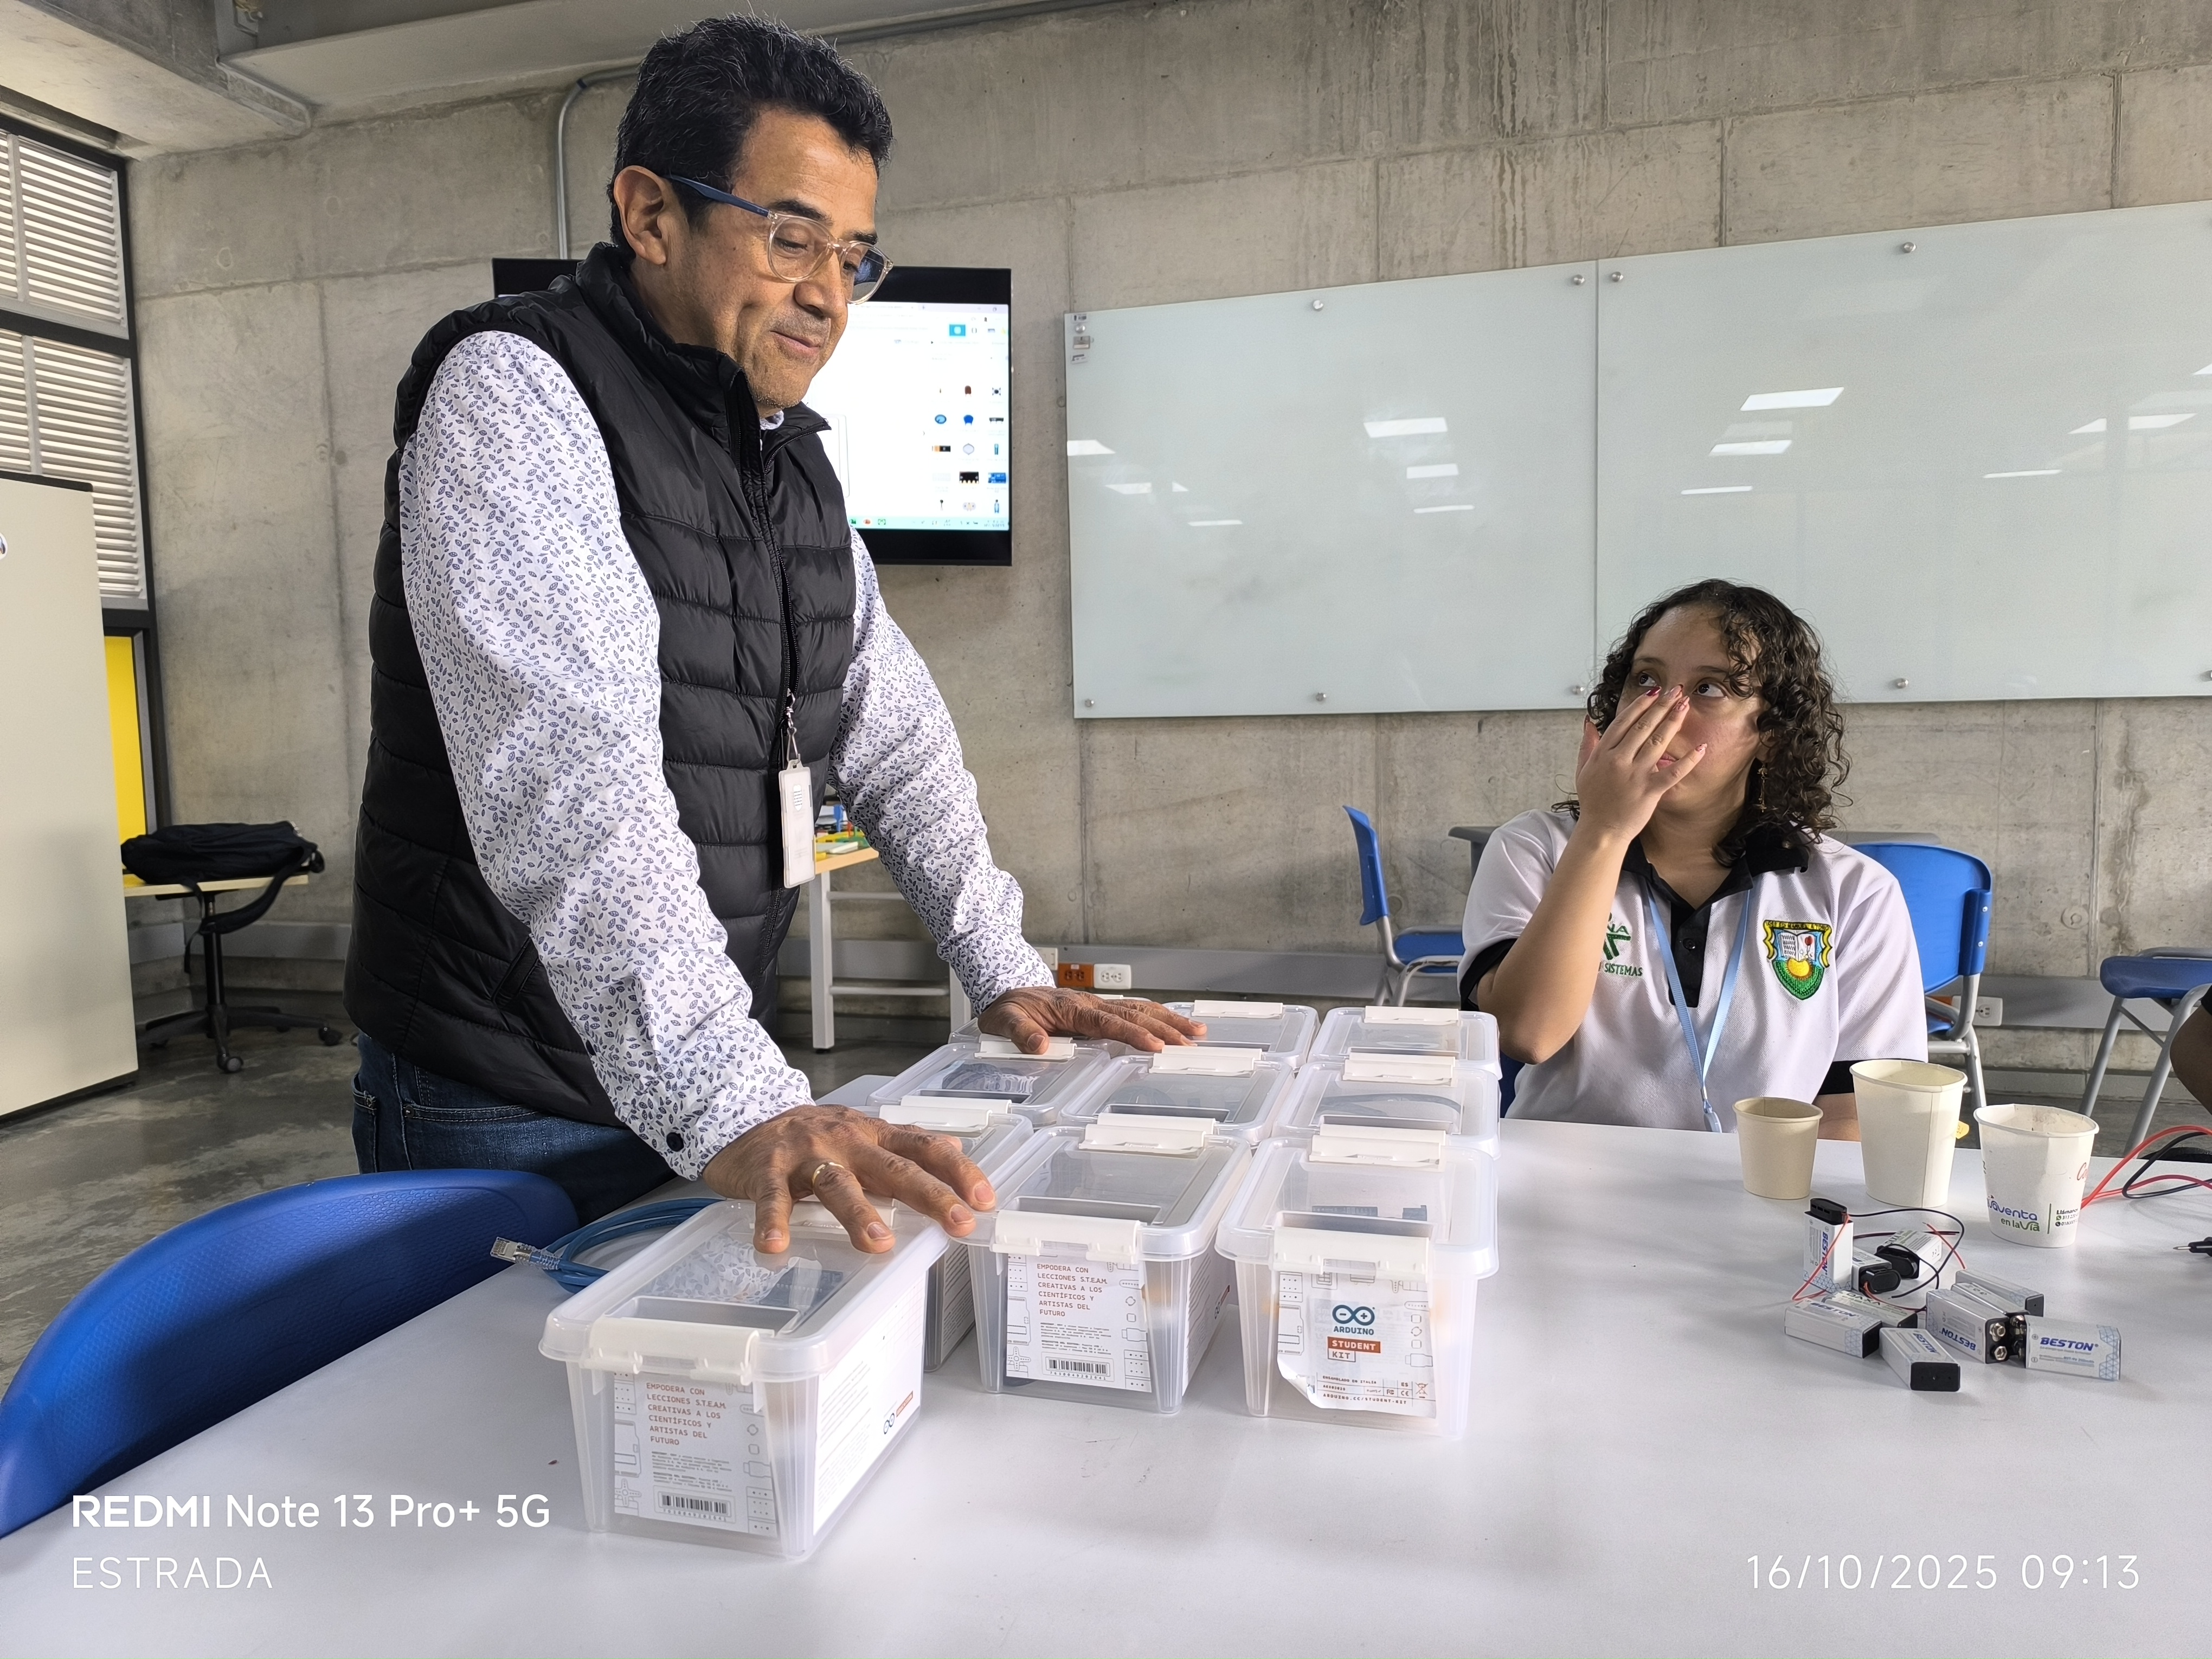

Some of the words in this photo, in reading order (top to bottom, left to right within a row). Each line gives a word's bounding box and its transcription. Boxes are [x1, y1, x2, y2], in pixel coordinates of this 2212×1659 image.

[1604, 963, 1643, 976] SISTEMAS
[2001, 1218, 2010, 1226] en
[1038, 1273, 1076, 1281] LECCIONES
[1038, 1282, 1076, 1290] CREATIVAS
[1039, 1291, 1085, 1301] CIENTÍFICOS
[1810, 1302, 1856, 1317] BESTON
[1333, 1326, 1374, 1335] ARDUINO
[1941, 1327, 1976, 1351] BESTON
[2040, 1337, 2094, 1351] BESTON
[1332, 1340, 1376, 1351] STUDENT
[1332, 1351, 1350, 1359] KIT
[646, 1382, 685, 1394] EMPODERA
[647, 1394, 691, 1404] LECCIONES
[648, 1404, 691, 1415] CREATIVAS
[649, 1415, 702, 1427] CIENTÍFICOS
[650, 1425, 688, 1436] ARTISTAS
[693, 1431, 708, 1439] DEL
[651, 1436, 679, 1445] FUTURO
